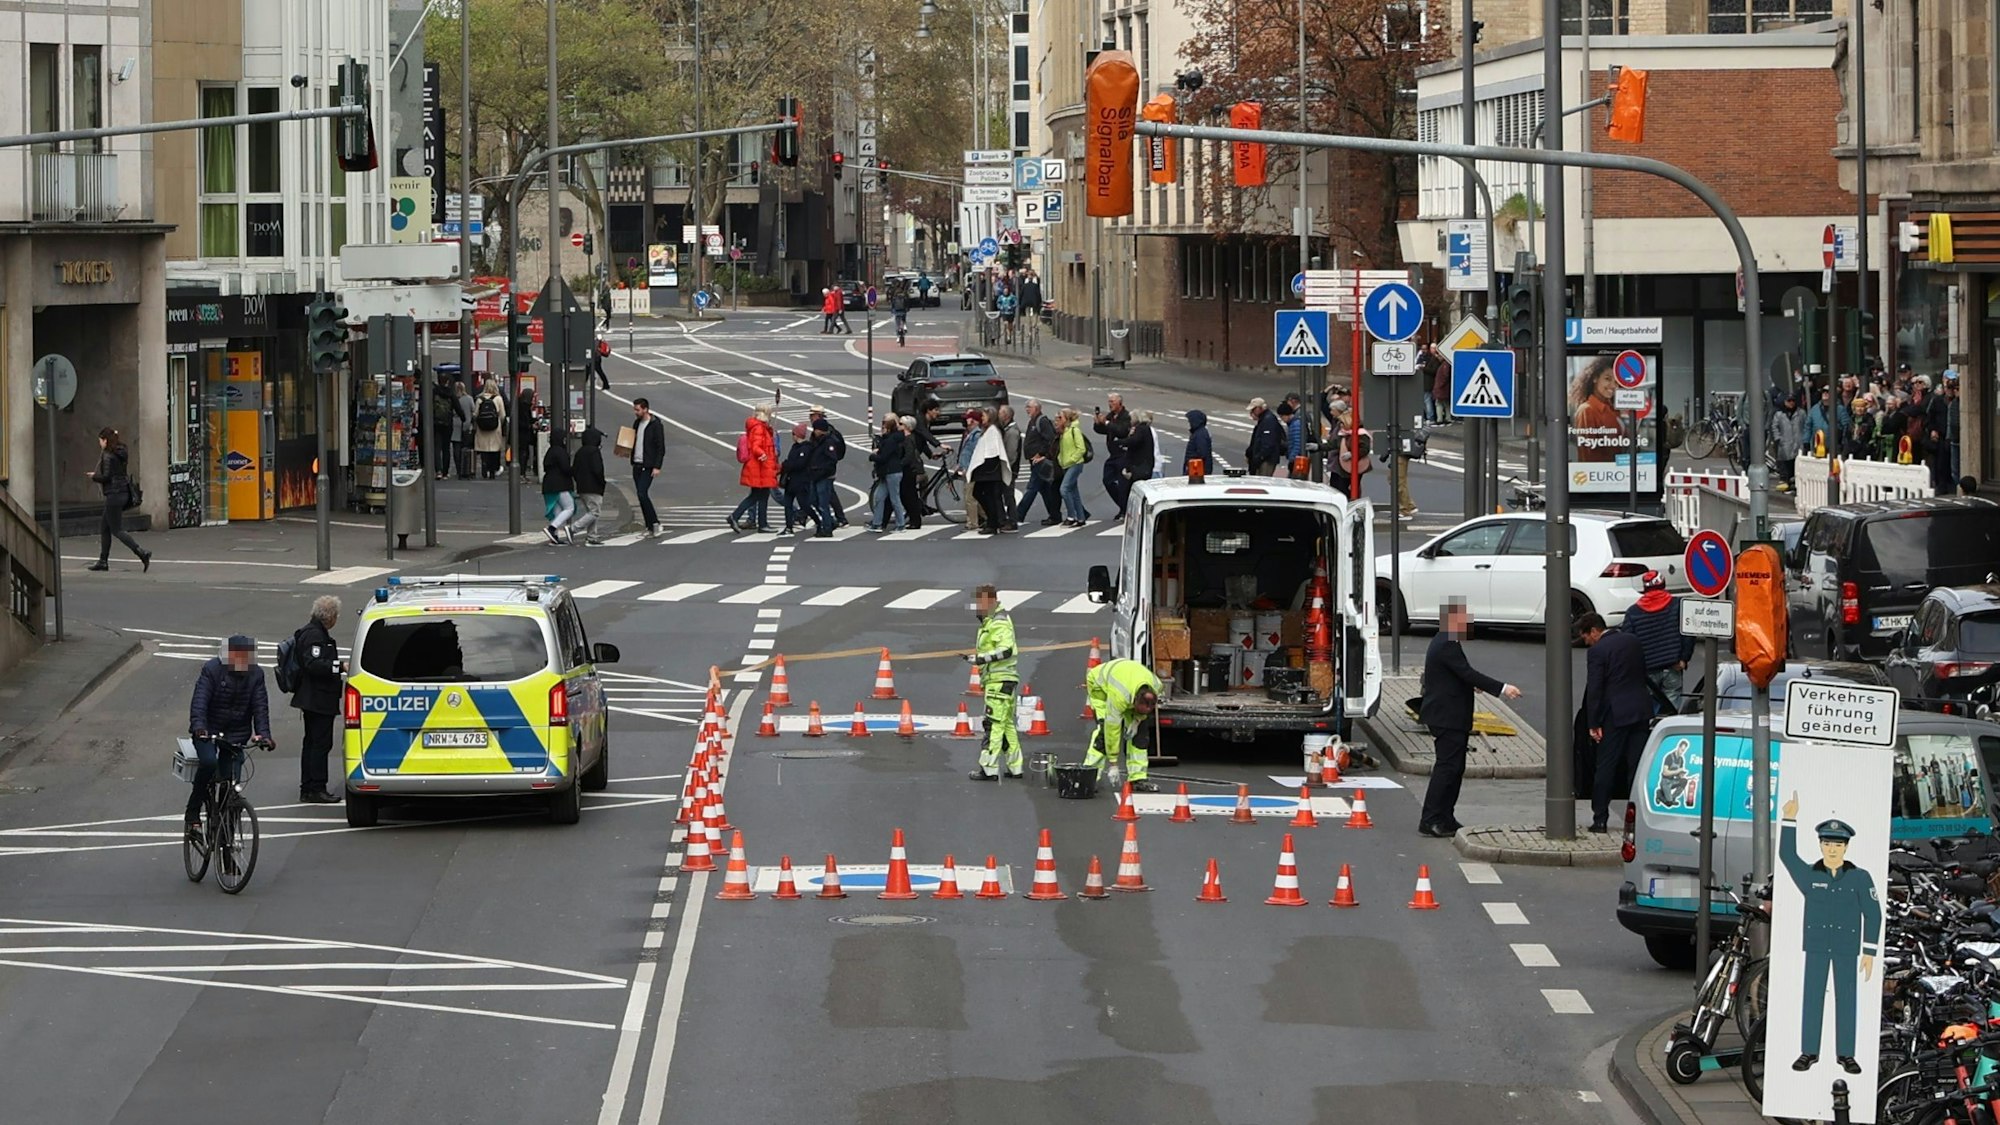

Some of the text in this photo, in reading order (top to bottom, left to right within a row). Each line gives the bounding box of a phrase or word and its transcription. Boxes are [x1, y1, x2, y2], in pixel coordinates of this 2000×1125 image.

[1097, 107, 1117, 197] Signalbau
[1026, 203, 1038, 217] P
[1586, 326, 1605, 335] Dom
[1608, 326, 1659, 336] Hauptbahnhof
[1387, 362, 1401, 371] frei
[1568, 426, 1618, 435] Fernstudium
[1577, 435, 1649, 449] Psycholoie
[1589, 471, 1647, 482] EURO-H
[1694, 607, 1720, 616] auf dem
[1685, 617, 1729, 629] Snstreifen
[1799, 687, 1884, 705] Verkehrs-
[362, 696, 430, 711] POLIZEI
[1807, 703, 1874, 722] führung
[1801, 719, 1877, 736] geändert
[428, 734, 448, 744] NRW
